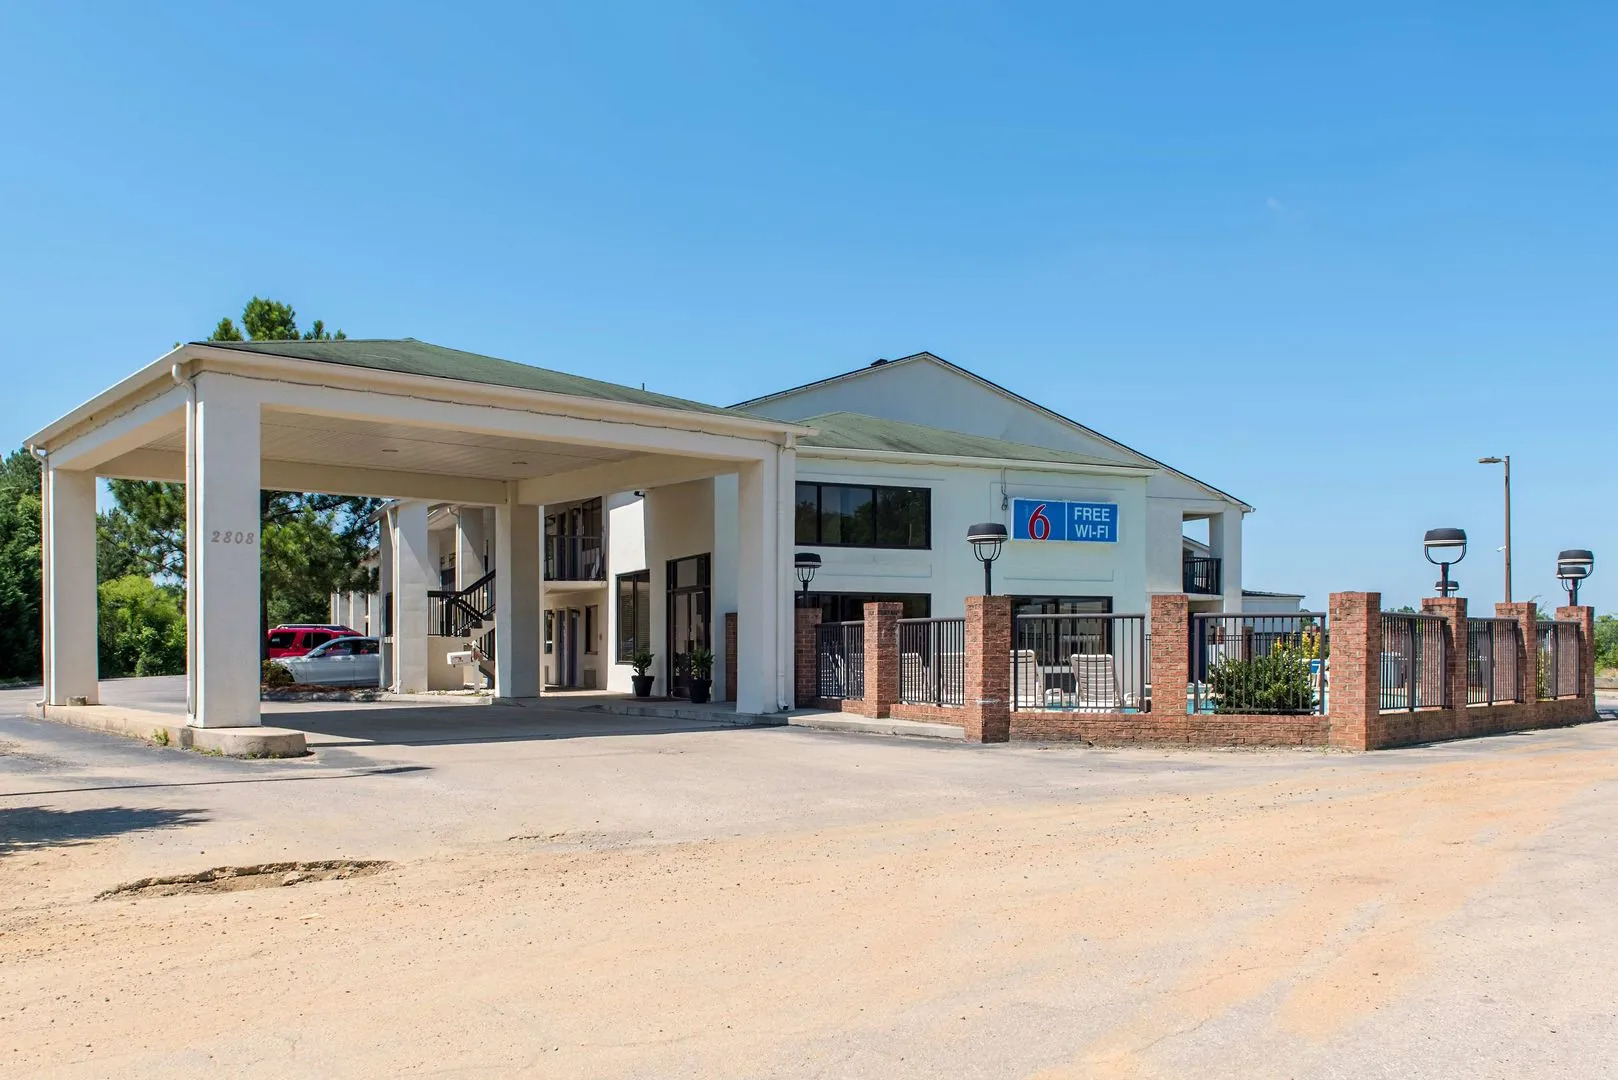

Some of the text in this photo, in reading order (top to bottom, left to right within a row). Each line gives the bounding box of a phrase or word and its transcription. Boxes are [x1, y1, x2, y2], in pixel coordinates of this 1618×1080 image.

[1074, 506, 1110, 522] FREE
[1028, 504, 1051, 541] 6
[211, 530, 254, 544] 2808
[1075, 524, 1109, 538] WI-FI
